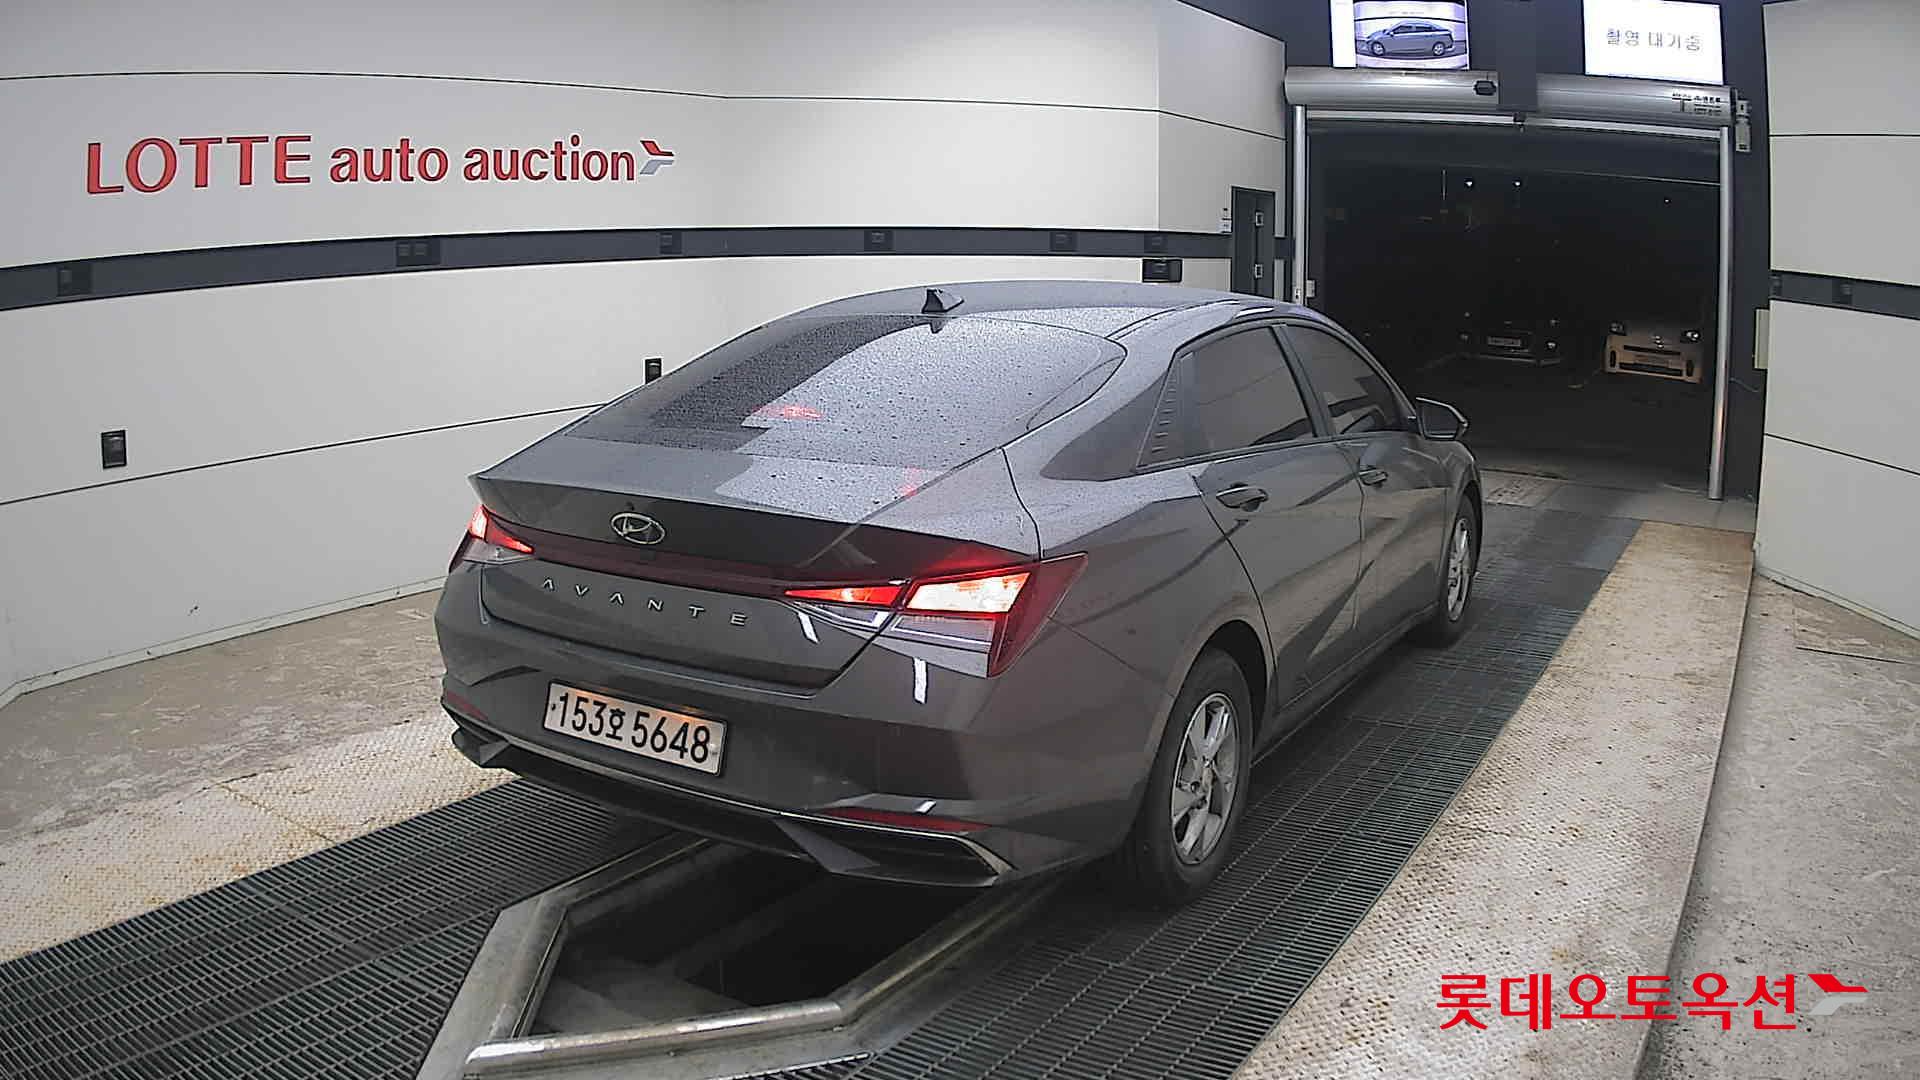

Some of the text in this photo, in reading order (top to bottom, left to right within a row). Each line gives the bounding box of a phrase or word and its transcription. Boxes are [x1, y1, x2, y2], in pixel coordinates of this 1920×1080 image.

[1648, 31, 1701, 51] 대기중
[86, 134, 635, 195] LOTTE auto auction
[542, 577, 749, 627] AVANTE
